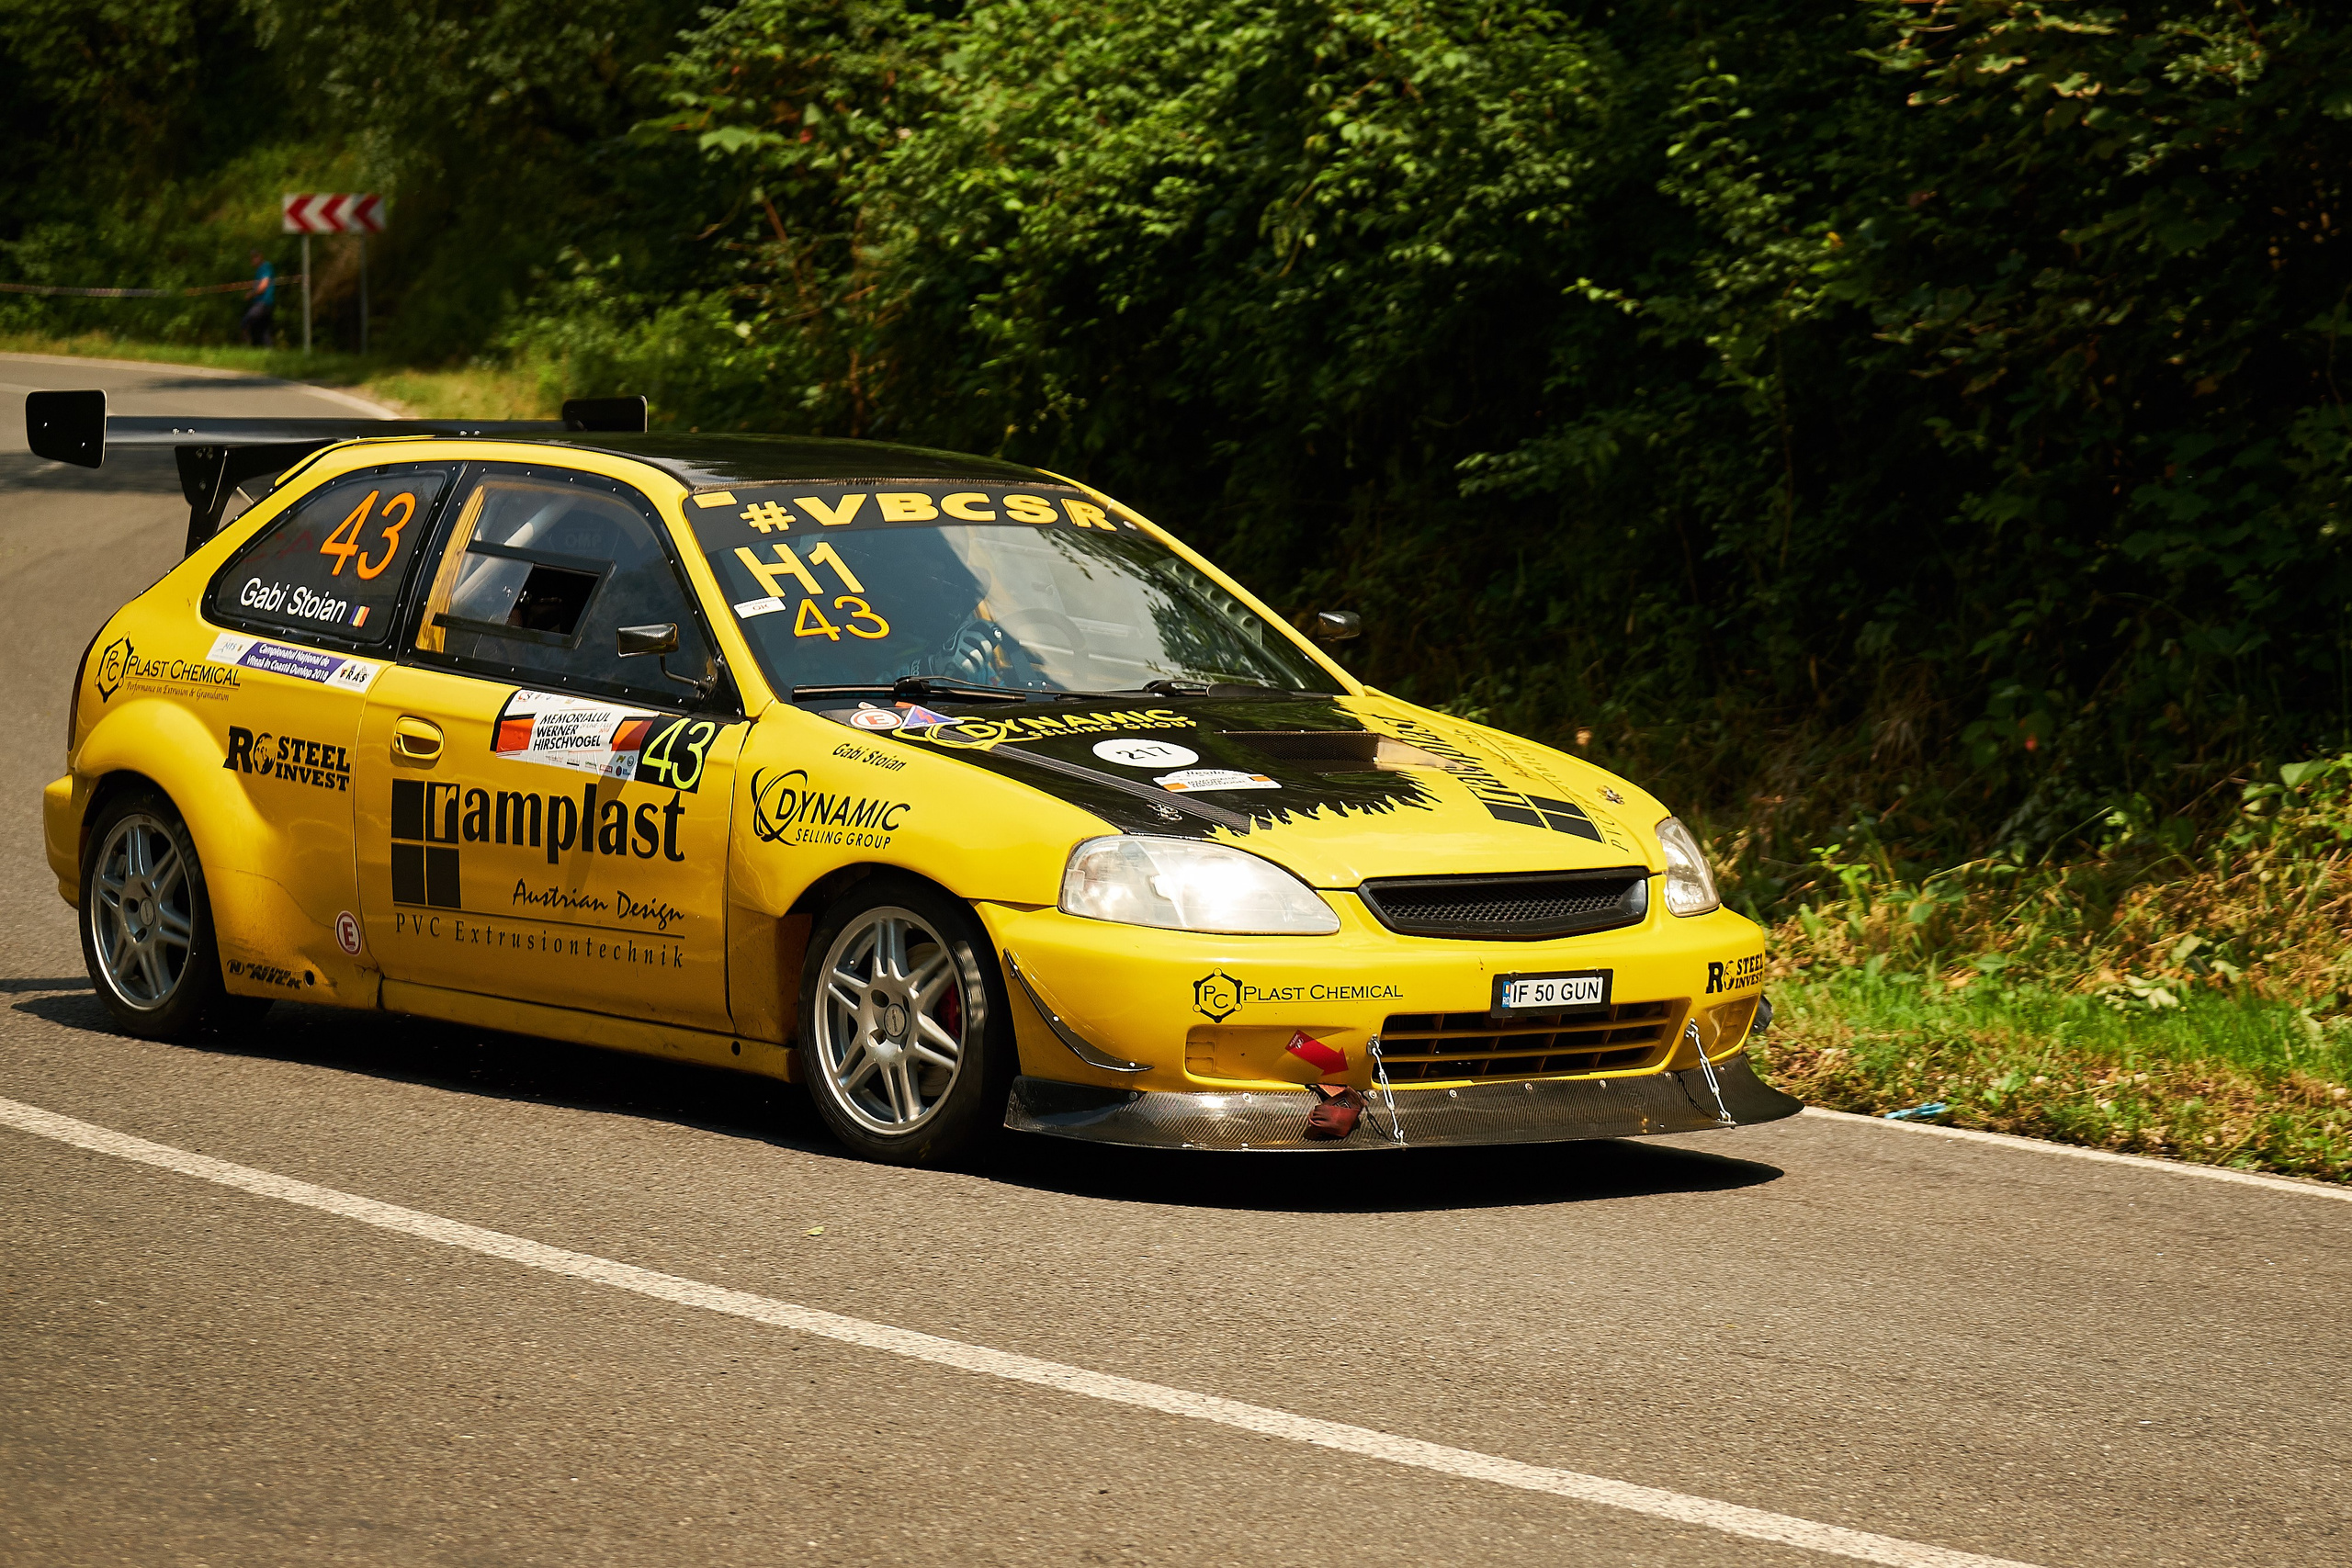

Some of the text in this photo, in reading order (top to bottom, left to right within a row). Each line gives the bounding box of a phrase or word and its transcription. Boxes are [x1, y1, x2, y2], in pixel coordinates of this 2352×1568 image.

[740, 492, 1118, 534] #VBCSR
[320, 490, 416, 580] 43
[734, 542, 865, 597] H1
[240, 577, 347, 623] Gabi Stoian
[794, 595, 890, 641] 43
[259, 643, 296, 660] Campionatul
[320, 656, 330, 667] de
[126, 656, 241, 687] PLAST CHEMICAL
[289, 663, 312, 679] Dunlop
[311, 669, 329, 682] 2018
[127, 680, 155, 695] Performance
[156, 685, 162, 694] in
[163, 684, 188, 696] Extrusion
[196, 688, 230, 701] Granulation
[537, 724, 579, 738] WERNER
[540, 712, 611, 725] MEMORIALUL
[865, 715, 889, 725] E
[956, 709, 1188, 739] DYNAMIC
[1028, 721, 1196, 737] SELLING GROUP
[277, 736, 351, 773] STEEL
[533, 735, 600, 750] HIRSCHVOGEL
[642, 717, 715, 790] 43
[1115, 746, 1171, 760] 217
[832, 743, 907, 772] Gabi Stoian
[275, 761, 350, 792] INVEST
[433, 783, 685, 863] ramplast
[775, 788, 910, 831] DYNAMIC
[796, 828, 891, 850] SELLING GROUP
[513, 878, 684, 930] Austrian Design
[343, 921, 356, 946] E
[396, 912, 684, 968] PVC Extrusiontechnik
[1736, 953, 1763, 976] STEEL
[1244, 985, 1403, 1000] PLAST CHEMICAL
[1513, 982, 1600, 1002] IF 50 GUN
[1735, 971, 1763, 989] INVEST
